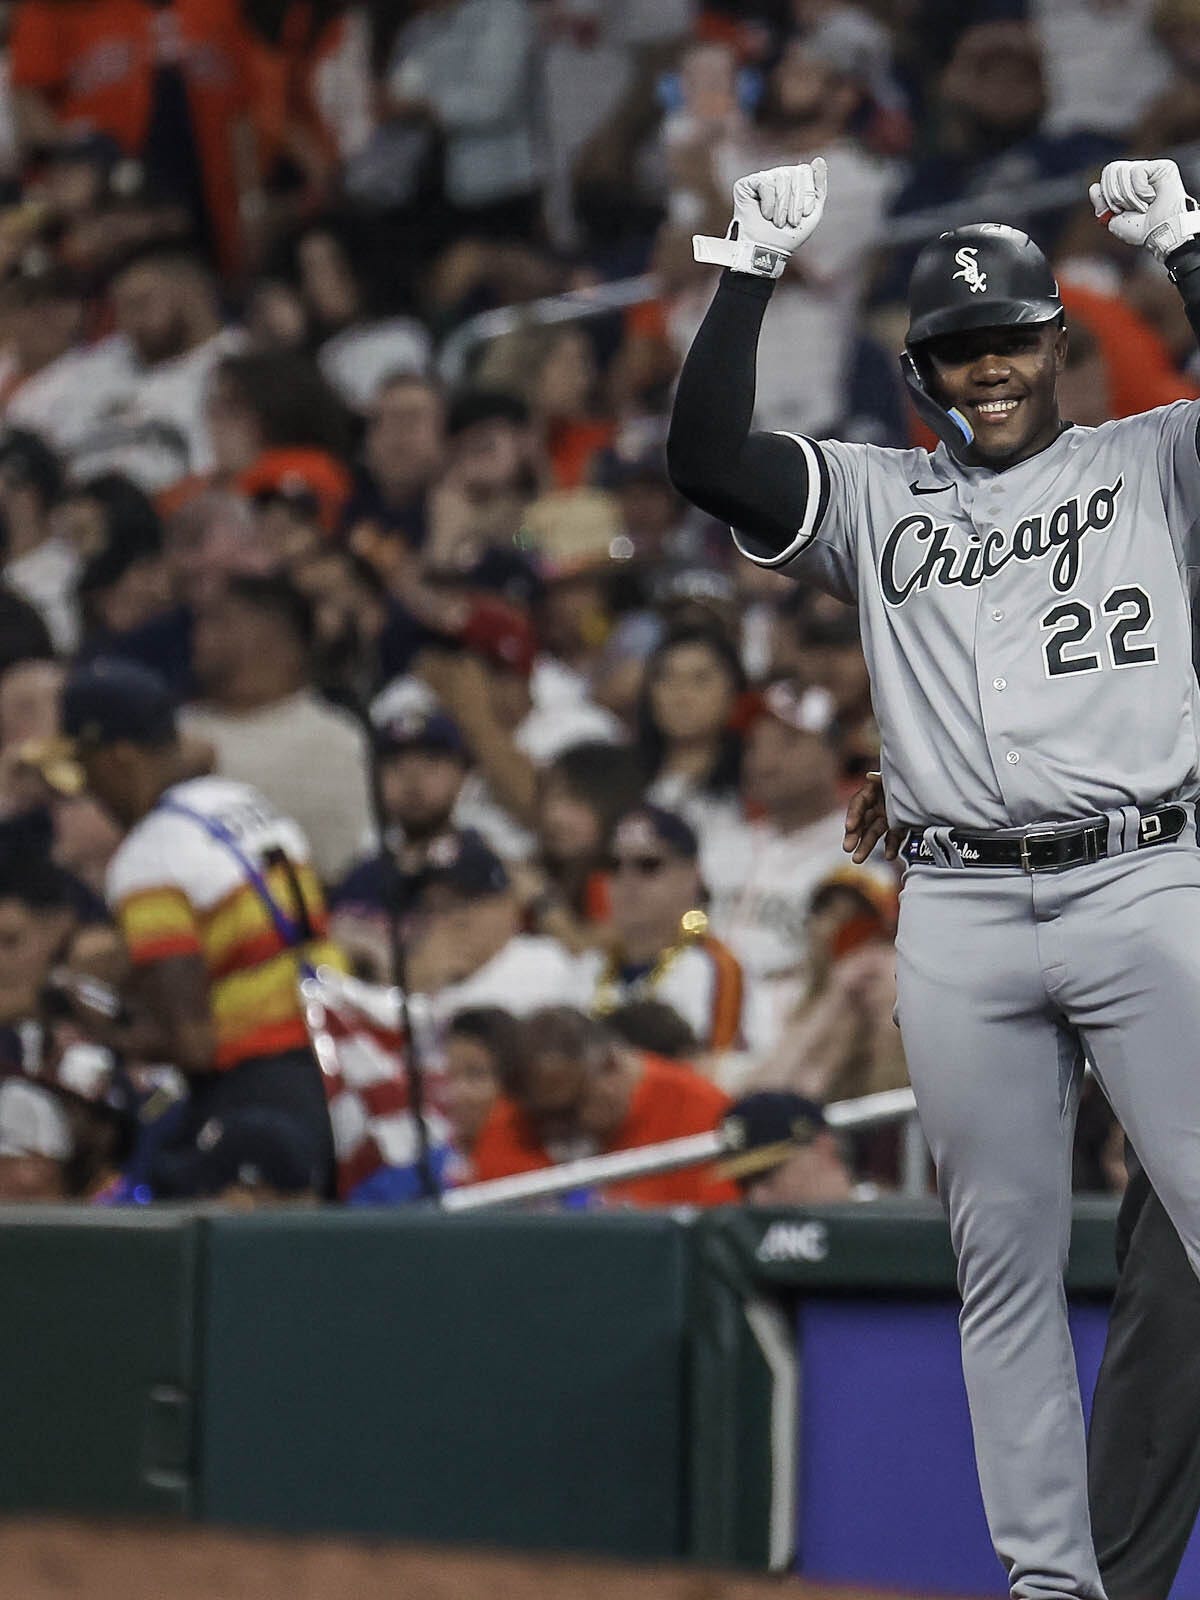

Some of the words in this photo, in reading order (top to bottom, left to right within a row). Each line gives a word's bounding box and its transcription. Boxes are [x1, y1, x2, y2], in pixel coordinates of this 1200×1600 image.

[952, 247, 987, 293] Sox
[880, 473, 1124, 608] Chicago
[1040, 583, 1160, 680] 22
